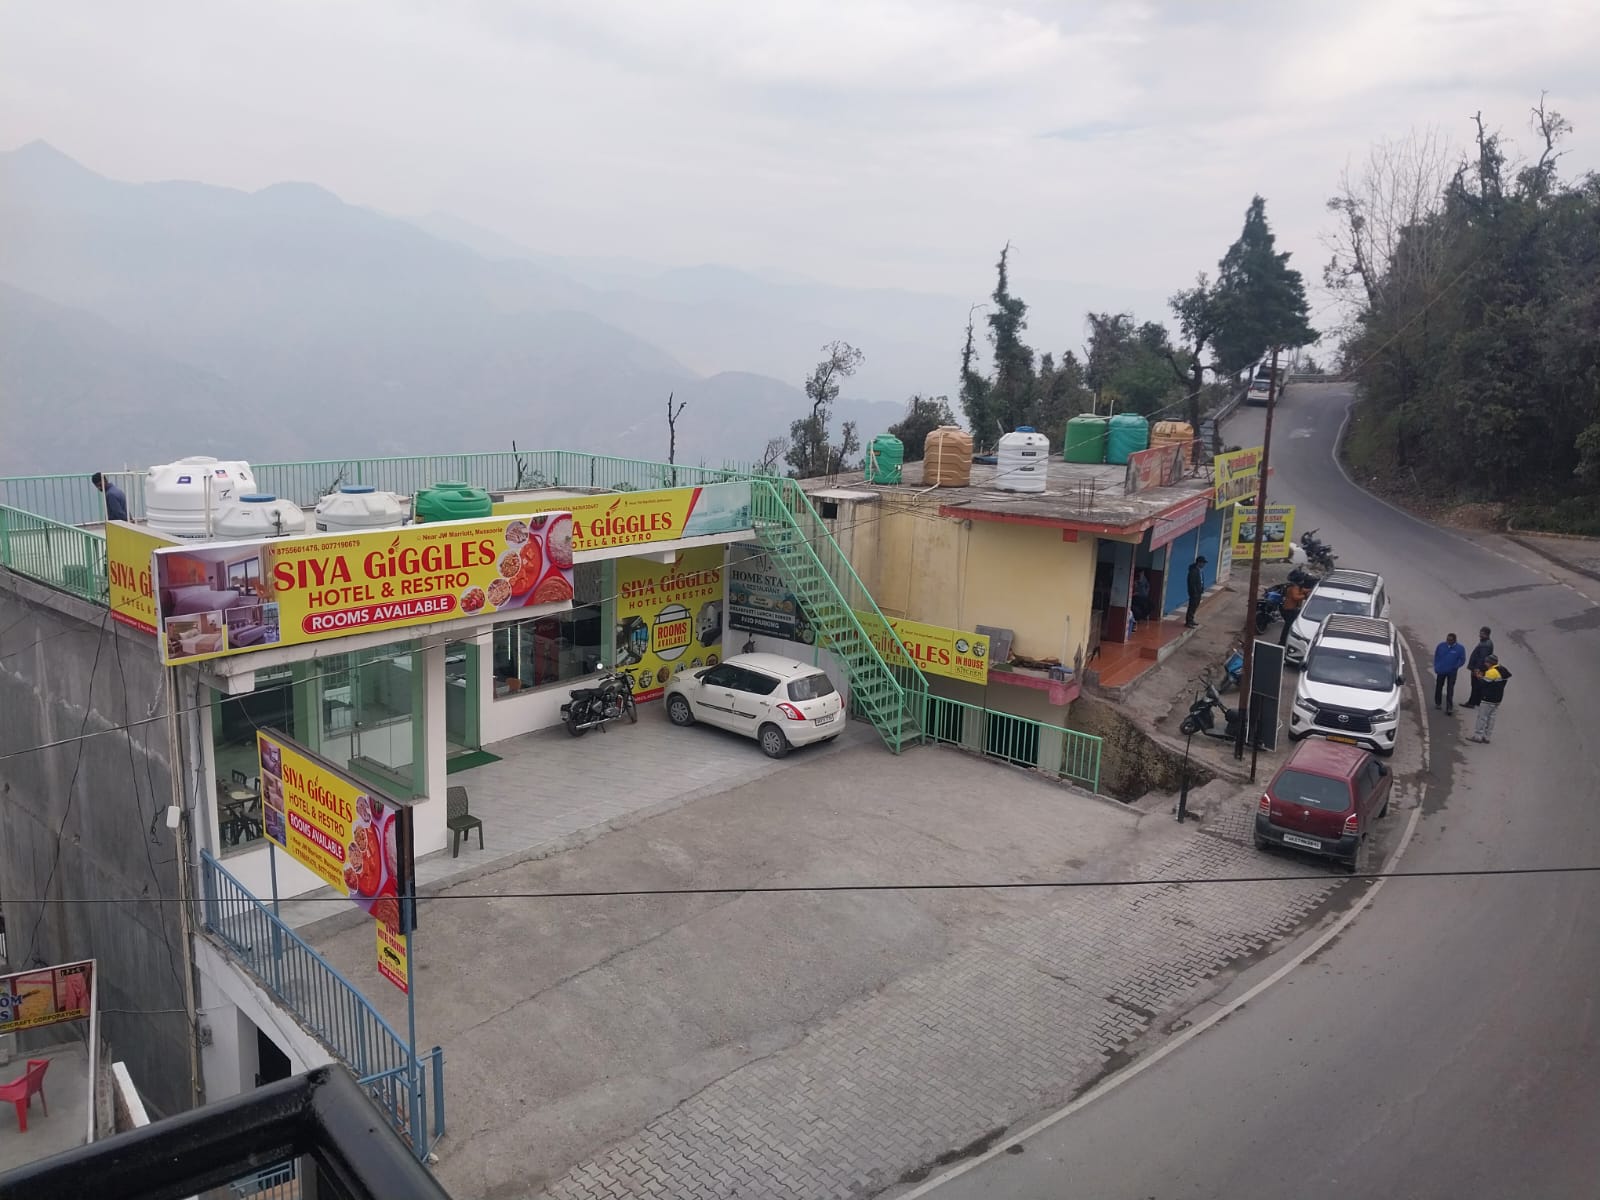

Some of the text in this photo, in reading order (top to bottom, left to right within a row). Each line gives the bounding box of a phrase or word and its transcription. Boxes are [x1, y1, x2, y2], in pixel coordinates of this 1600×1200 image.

[422, 533, 437, 541] Near
[438, 532, 448, 540] JW
[572, 538, 598, 549] OTEL
[611, 532, 652, 544] RESTRO
[110, 560, 136, 593] SIYA
[273, 555, 352, 592] SIYA
[732, 570, 788, 588] HOME STA
[308, 572, 470, 609] HOTEL & RESTRO
[621, 577, 655, 599] SIYA
[629, 587, 714, 610] HOTEL & RESTRO
[312, 597, 449, 631] ROOMS AVAILABLE
[657, 622, 687, 639] ROOMS
[657, 634, 687, 648] AVAILABLE
[955, 655, 984, 670] IN HOUSE
[283, 764, 304, 793] SIYA
[289, 791, 344, 837] HOTEL & RESTRO
[289, 813, 343, 860] ROOMS AVAILABLE
